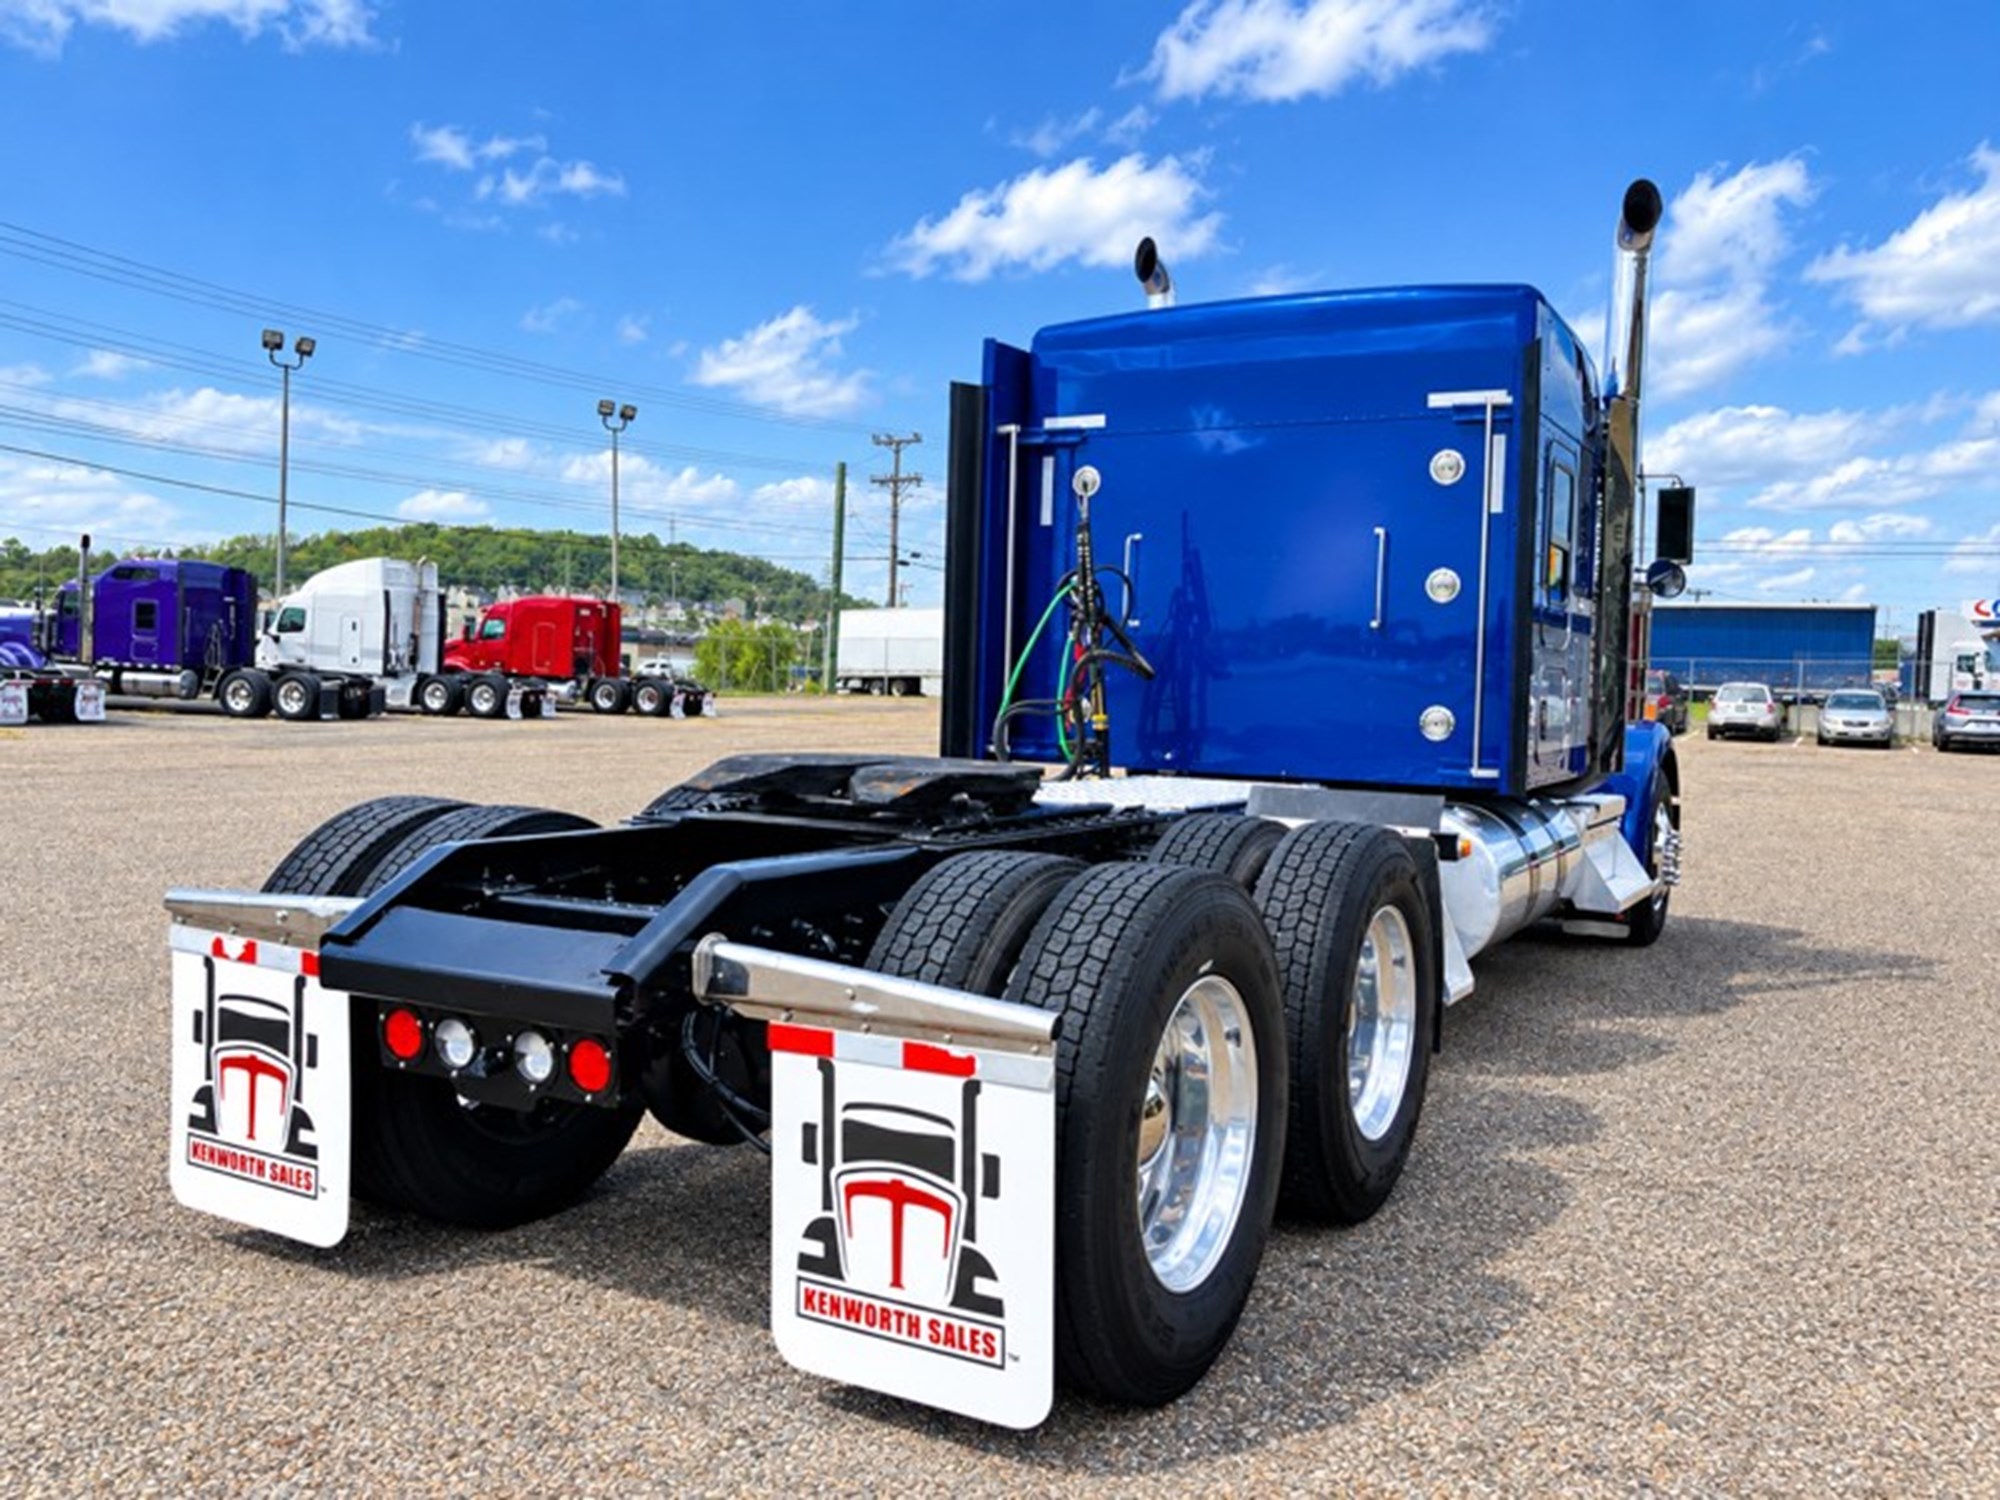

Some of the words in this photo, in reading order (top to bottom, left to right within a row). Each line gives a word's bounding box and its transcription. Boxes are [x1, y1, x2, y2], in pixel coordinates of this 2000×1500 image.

[191, 1141, 266, 1178] KENWORTH
[269, 1161, 313, 1191] SALES
[803, 1286, 921, 1339] KENWORTH
[927, 1317, 997, 1359] SALES
